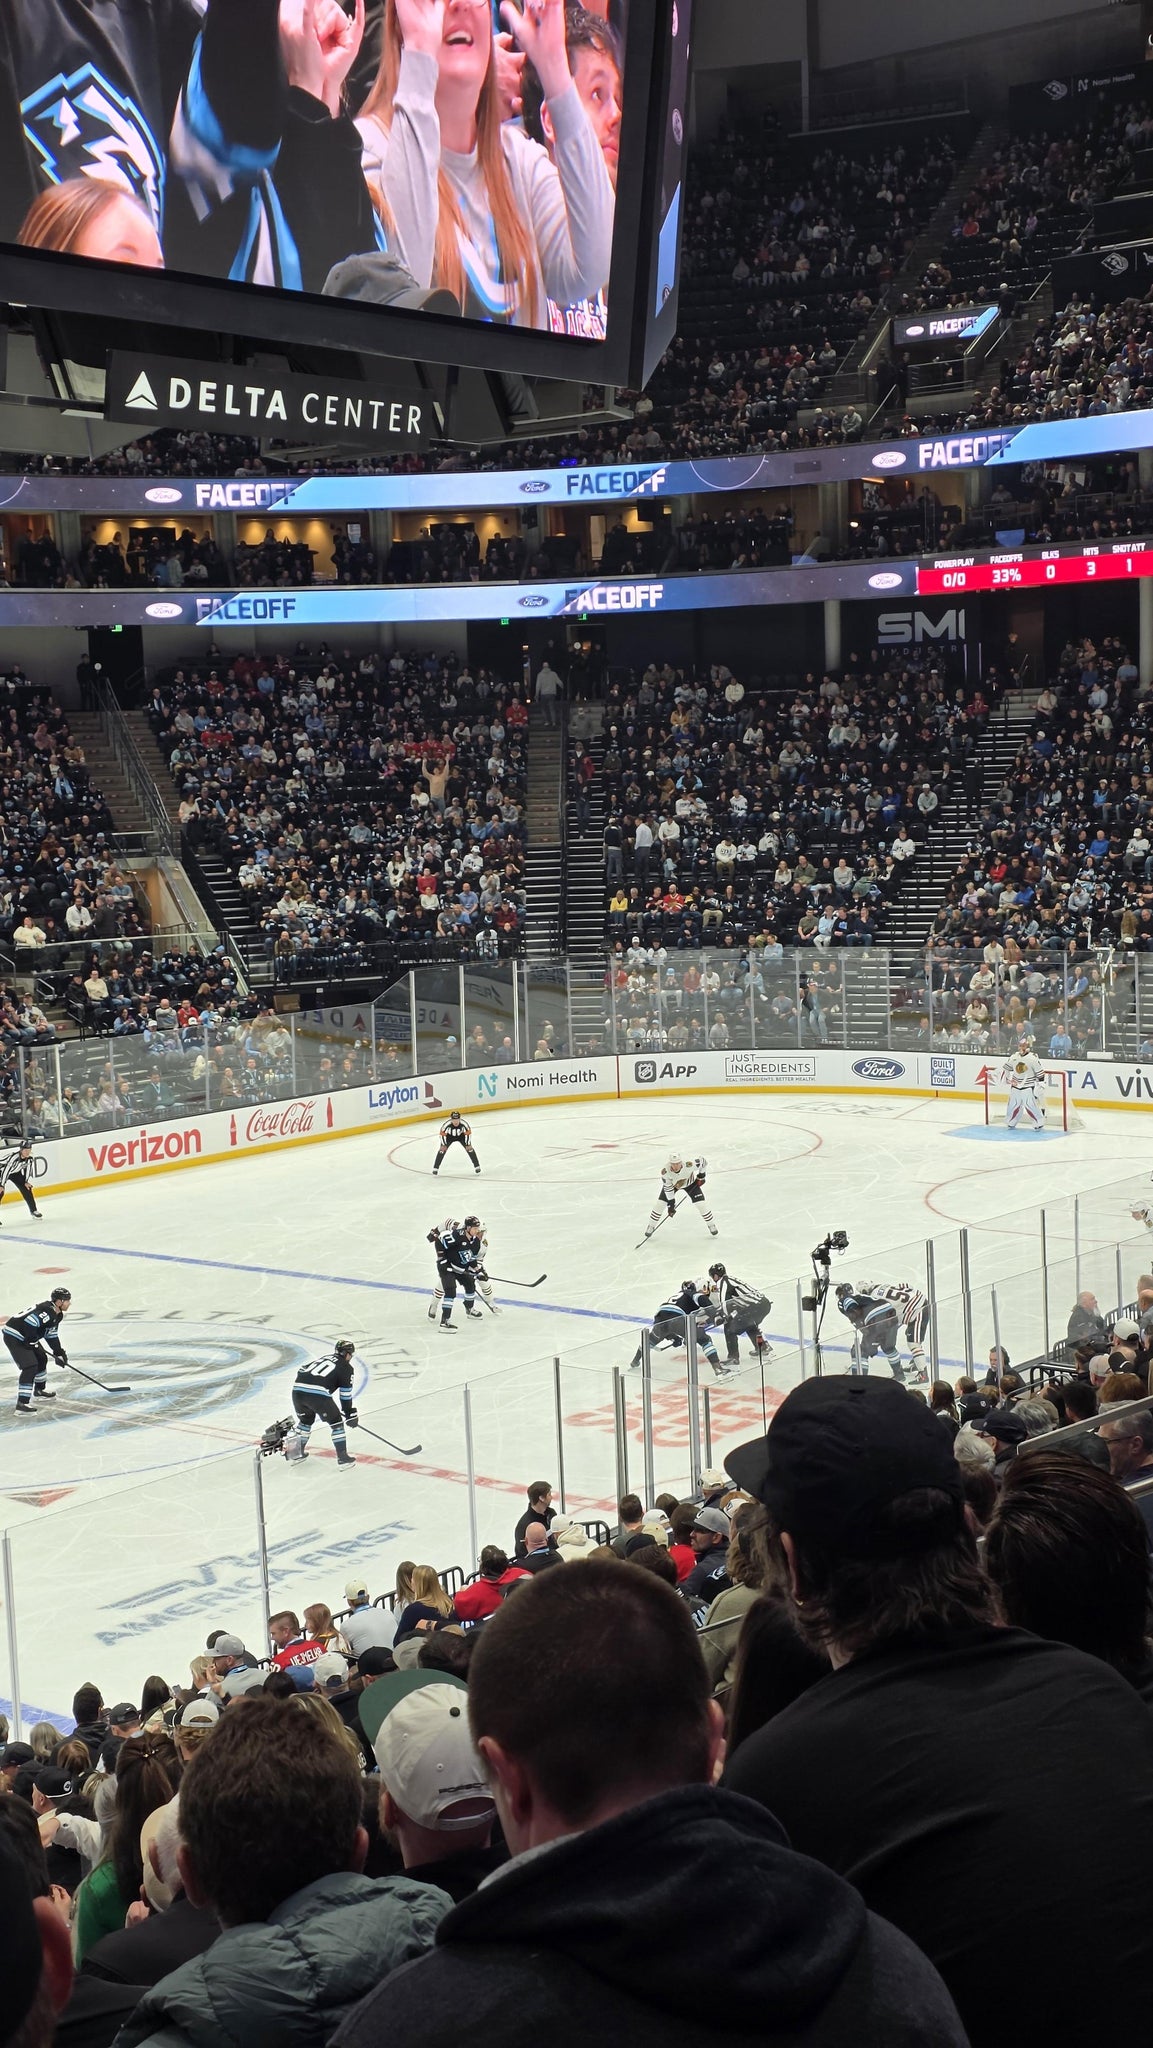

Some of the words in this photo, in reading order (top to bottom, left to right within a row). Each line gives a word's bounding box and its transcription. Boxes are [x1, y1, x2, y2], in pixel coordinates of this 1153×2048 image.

[929, 316, 979, 335] FACEOFF
[169, 377, 287, 420] DELTA
[302, 393, 421, 434] CENTER
[919, 434, 1014, 468] FACEOFF
[566, 468, 666, 495] FACEOFF
[196, 483, 298, 507] FACEOFF
[990, 554, 1023, 565] FACEOFFS
[1041, 551, 1059, 560] BLKS
[1083, 547, 1099, 556] HITS
[1046, 565, 1056, 579] 0
[1086, 562, 1096, 575] 3
[1126, 558, 1132, 572] 1
[943, 572, 966, 587] 0/0
[992, 568, 1022, 583] 33%
[565, 584, 664, 612] FACEOFF
[196, 598, 296, 620] FACEOFF
[731, 1054, 756, 1062] JUST
[933, 1060, 953, 1069] BUILT
[731, 1064, 811, 1074] INGREDIENTS
[861, 1060, 896, 1076] Ford
[507, 1073, 543, 1089] Nomi
[549, 1070, 597, 1085] Health
[933, 1077, 953, 1085] TOUGH
[369, 1085, 419, 1110] Layton
[246, 1100, 316, 1142] Coca-Cola
[88, 1129, 202, 1171] verizon
[64, 1310, 275, 1325] DELTA
[300, 1323, 419, 1381] CENTER
[94, 1564, 303, 1647] AMERICA
[294, 1520, 417, 1566] FIRST
